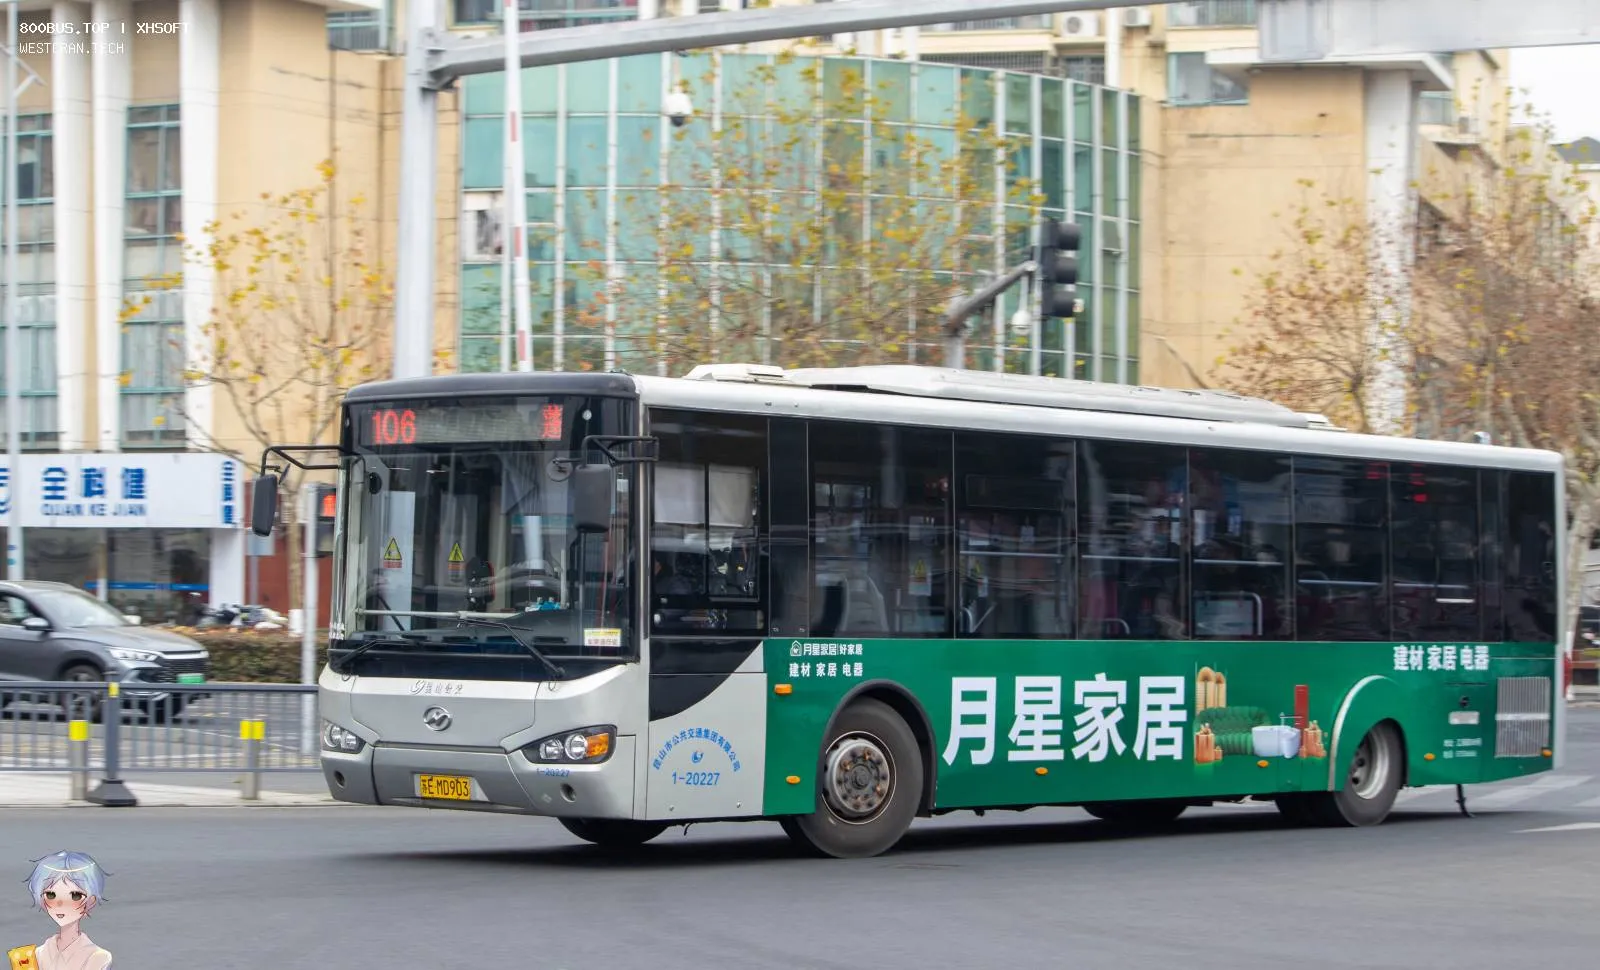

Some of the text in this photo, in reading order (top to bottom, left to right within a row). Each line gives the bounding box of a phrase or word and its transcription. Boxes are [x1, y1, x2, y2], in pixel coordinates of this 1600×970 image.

[372, 409, 416, 444] 106
[803, 643, 863, 656] 月星家居 好家居
[1393, 645, 1489, 671] 建材 家居 电器
[789, 662, 863, 677] 建材 家居 电器
[942, 672, 1187, 766] 月星家居
[652, 727, 741, 772] 昆山市公共交通集团有限公司
[672, 772, 720, 786] 1-20227
